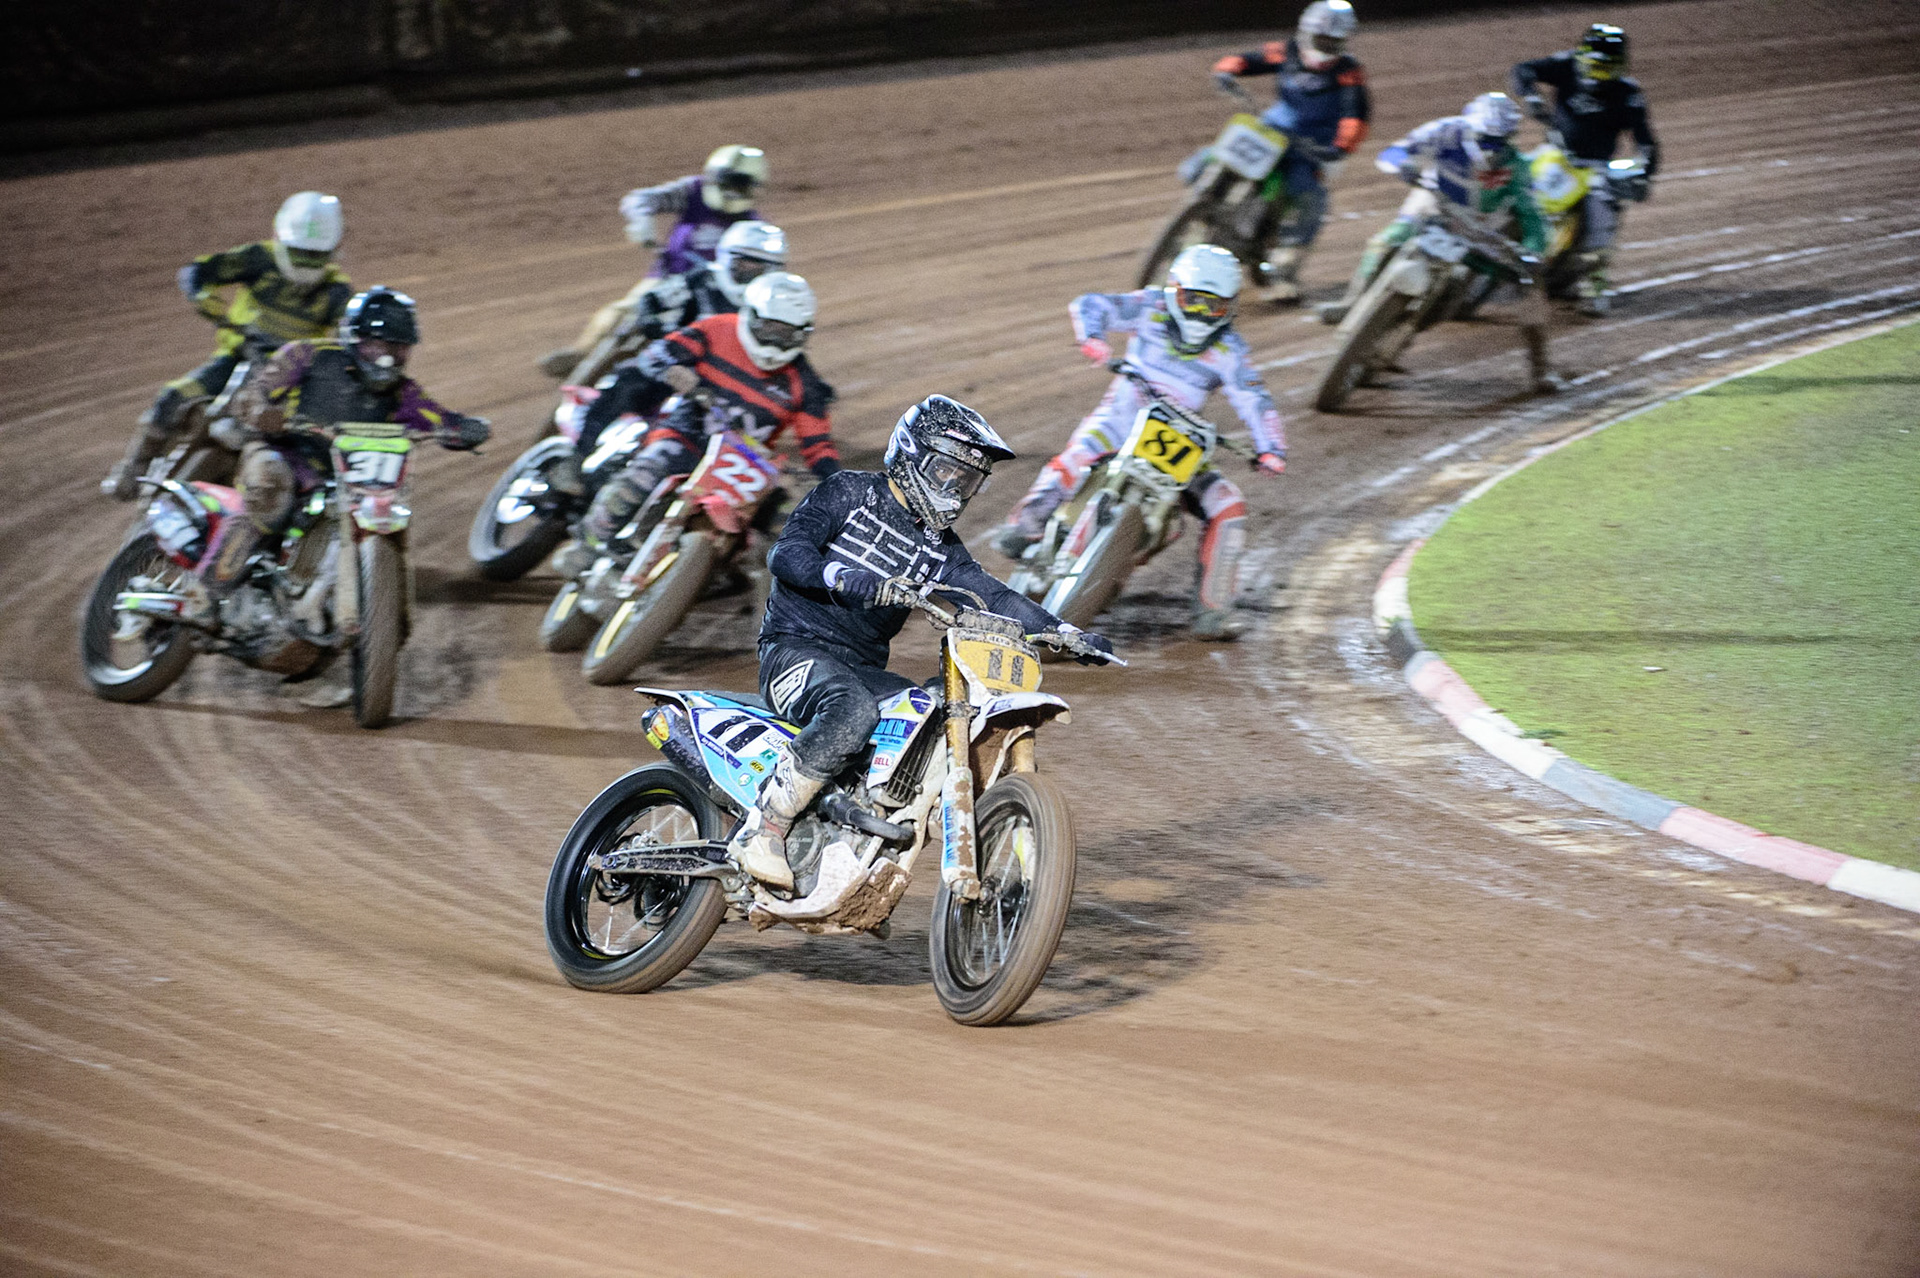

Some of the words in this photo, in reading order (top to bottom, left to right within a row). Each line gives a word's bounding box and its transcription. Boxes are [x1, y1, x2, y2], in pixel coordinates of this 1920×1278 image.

[344, 451, 405, 482] 31
[712, 453, 767, 502] 22
[986, 648, 1025, 687] 11
[707, 715, 769, 753] 11
[873, 756, 889, 766] BELL
